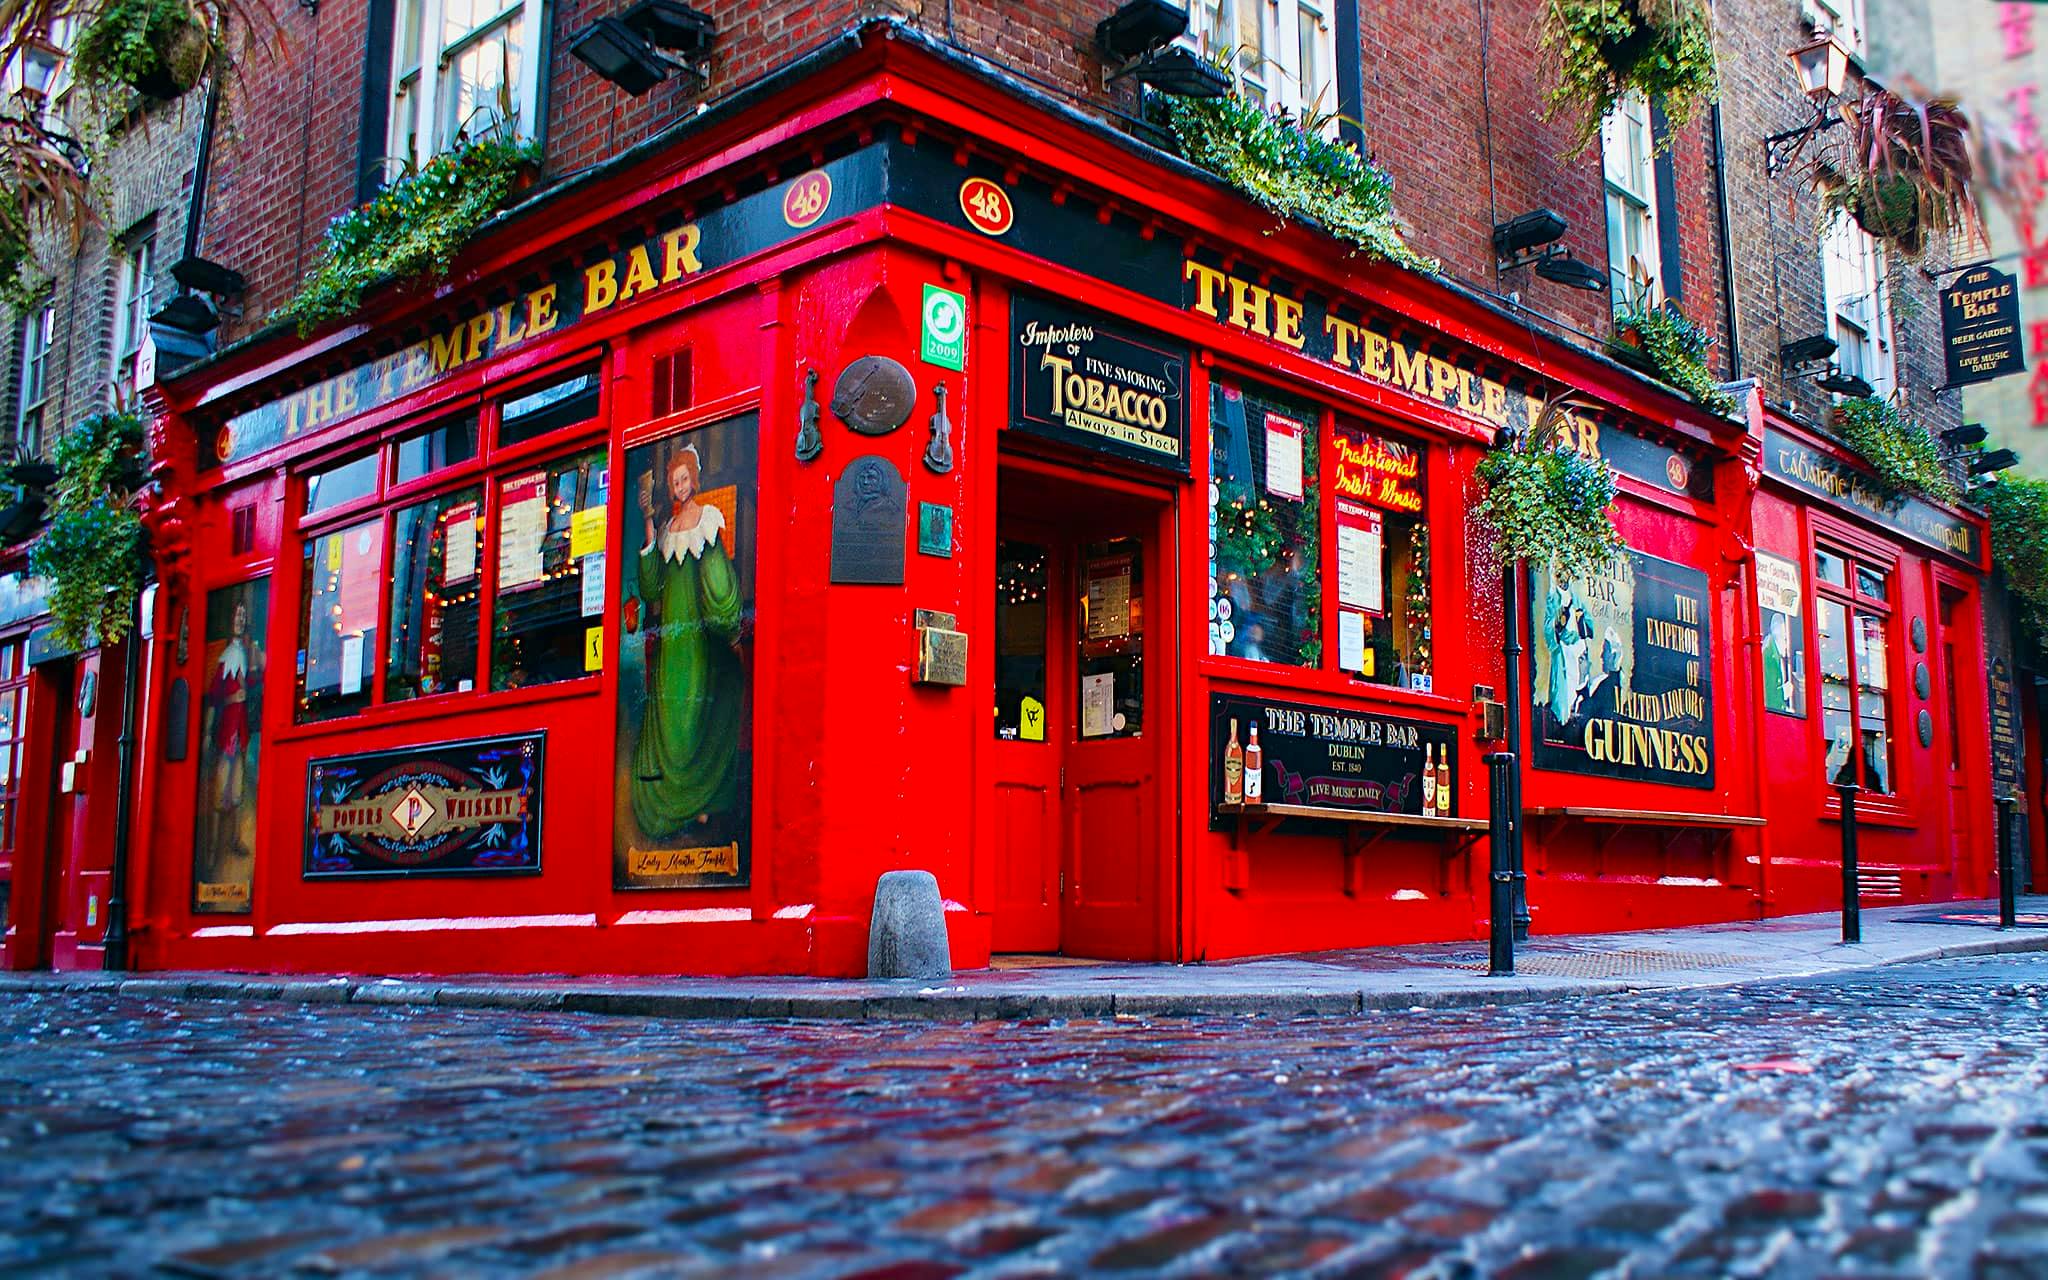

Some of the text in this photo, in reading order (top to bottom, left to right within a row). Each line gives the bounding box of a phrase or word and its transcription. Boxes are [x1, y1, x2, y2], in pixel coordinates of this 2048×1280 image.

[791, 181, 823, 219] 48
[969, 186, 1003, 224] 48
[1967, 271, 1989, 284] THE
[1948, 285, 2011, 308] TEMPLE
[1963, 302, 1999, 320] BAR
[285, 223, 703, 435] THE TEMPLE BAR
[1020, 320, 1094, 355] Importers
[1186, 260, 1306, 349] THE
[1325, 313, 1508, 426] TEMPLE
[1952, 326, 2013, 345] BEER GARDEN
[930, 341, 958, 360] 2009
[1066, 343, 1081, 356] OF
[1960, 350, 2010, 367] LIVE MUSIC
[1086, 357, 1166, 394] FINE SMOKING
[1972, 362, 1997, 372] DAILY
[1040, 352, 1167, 431] TOBACCO
[1068, 411, 1177, 453] Always in Stock
[1333, 438, 1417, 478] Traditional
[1668, 462, 1682, 483] 48
[1334, 463, 1422, 512] Irish Music
[1586, 576, 1618, 607] BAR
[1674, 593, 1698, 624] THE
[1646, 617, 1699, 656] EMPEROR
[1686, 659, 1699, 687] OF
[1612, 685, 1705, 723] MALTED LIQUORS
[1265, 707, 1420, 749] THE TEMPLE BAR
[1328, 744, 1365, 760] DUBLIN
[1584, 717, 1709, 776] GUINNESS
[1332, 761, 1346, 772] EST.
[1310, 783, 1382, 800] LIVE MUSIC DAILY
[333, 795, 513, 831] POWERS P WHISKEY
